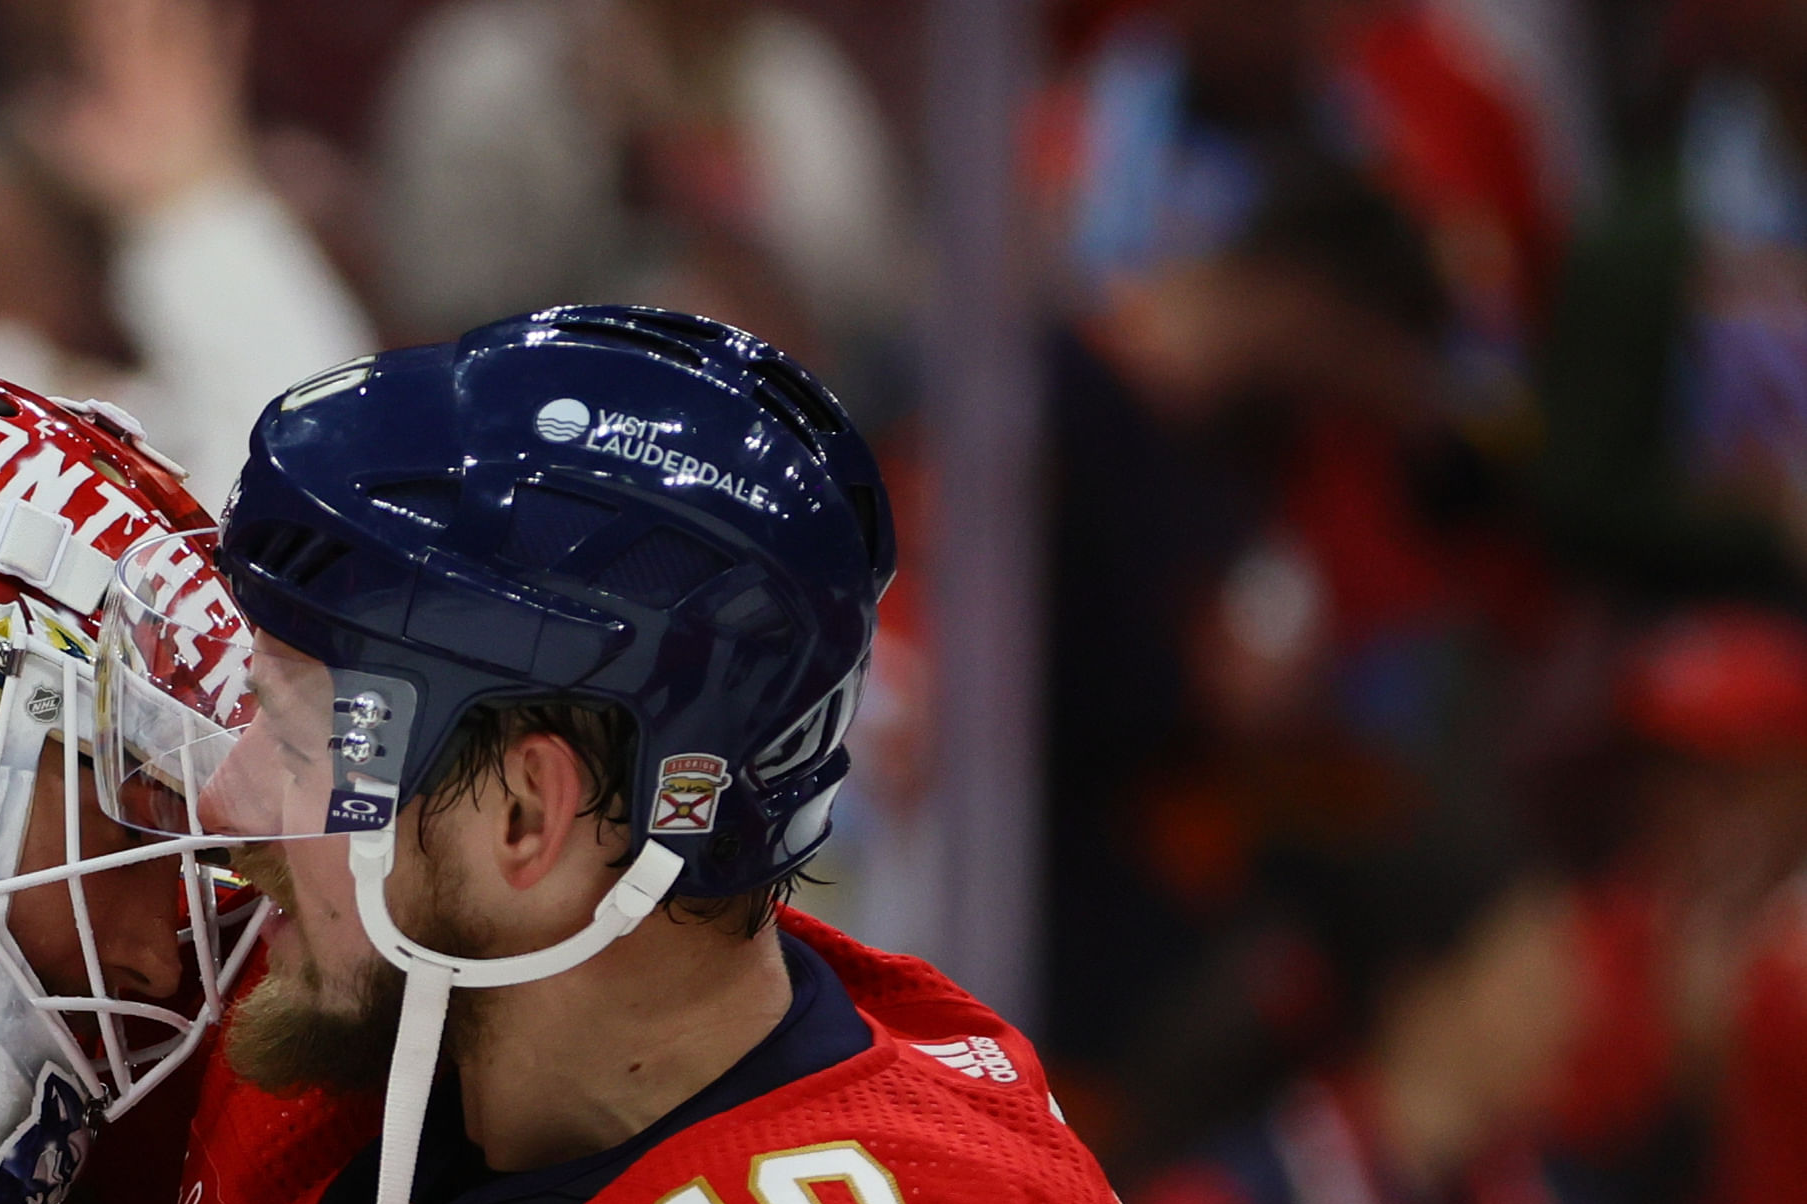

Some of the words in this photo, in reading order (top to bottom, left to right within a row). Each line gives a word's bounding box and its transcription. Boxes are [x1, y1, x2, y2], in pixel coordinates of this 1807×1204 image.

[597, 409, 661, 442] VISIT
[586, 428, 770, 509] LAUDERDALE
[968, 1036, 1018, 1083] adidas
